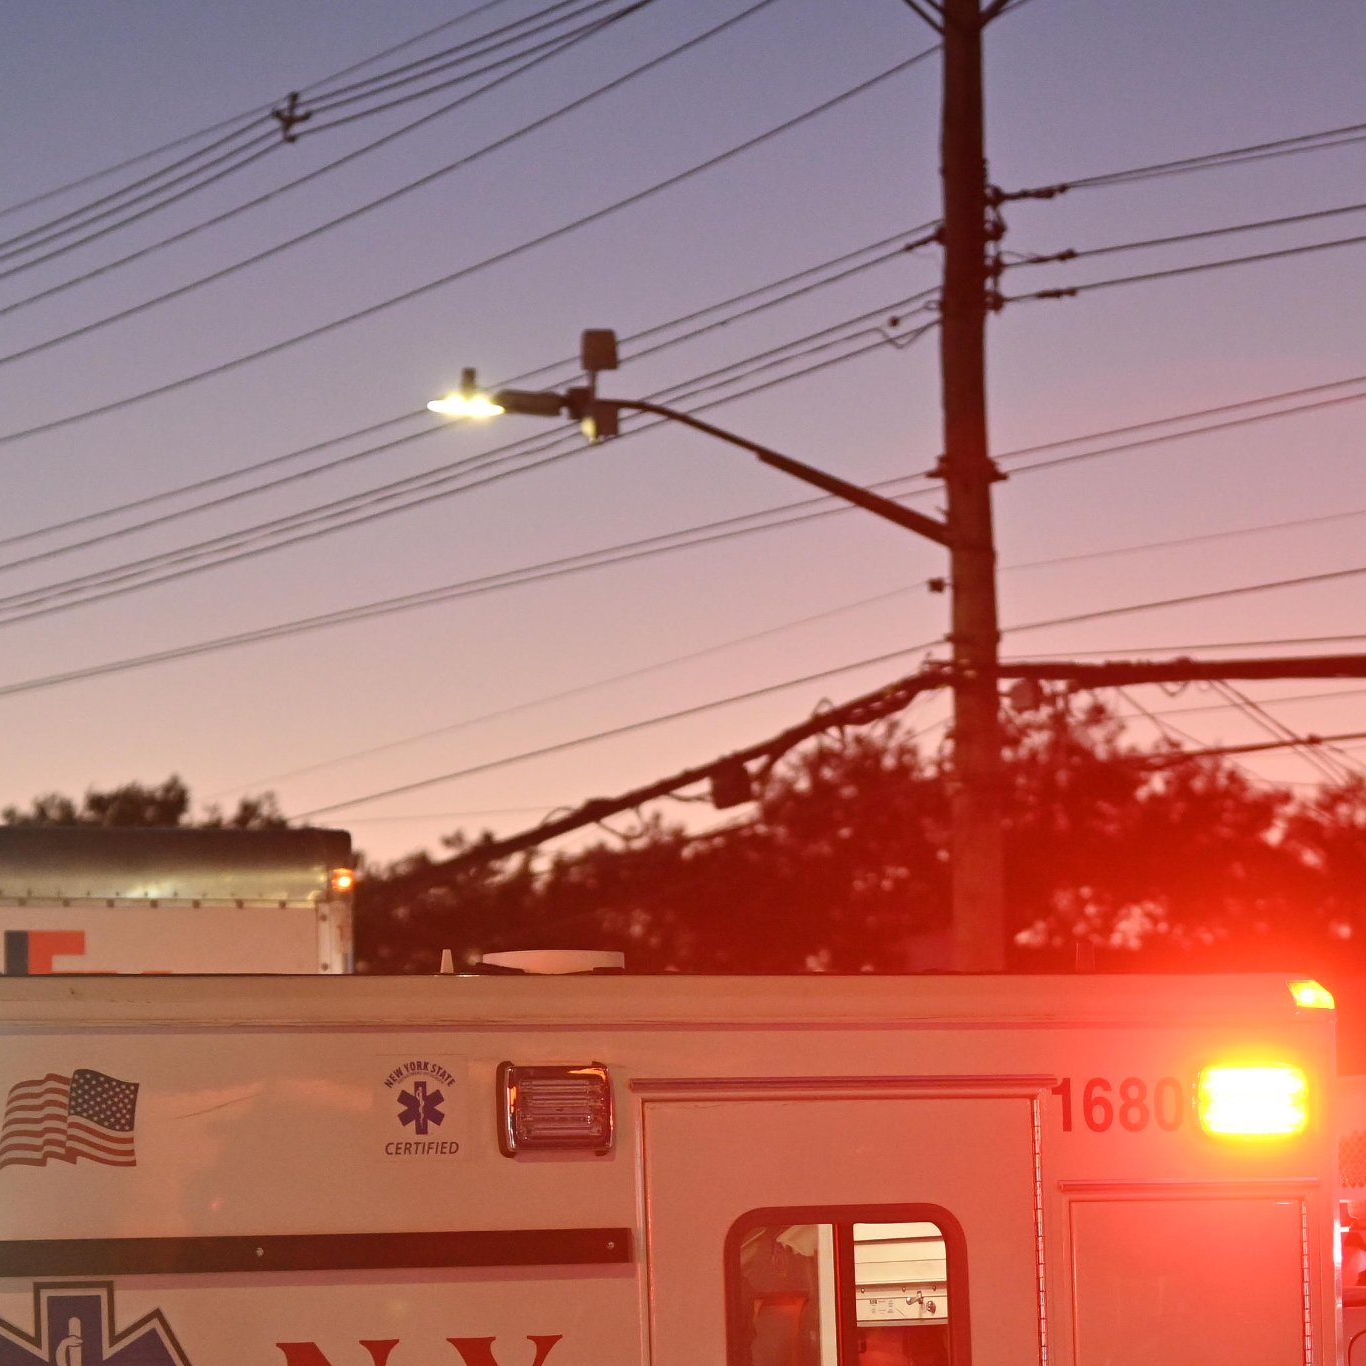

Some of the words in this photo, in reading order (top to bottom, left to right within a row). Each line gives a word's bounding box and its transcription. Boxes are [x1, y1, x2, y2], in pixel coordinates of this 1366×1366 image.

[384, 1066, 404, 1089] NEW
[403, 1060, 430, 1073] YORK
[430, 1063, 457, 1088] STATE
[1051, 1076, 1184, 1133] 1680
[385, 1141, 459, 1156] CERTIFIED
